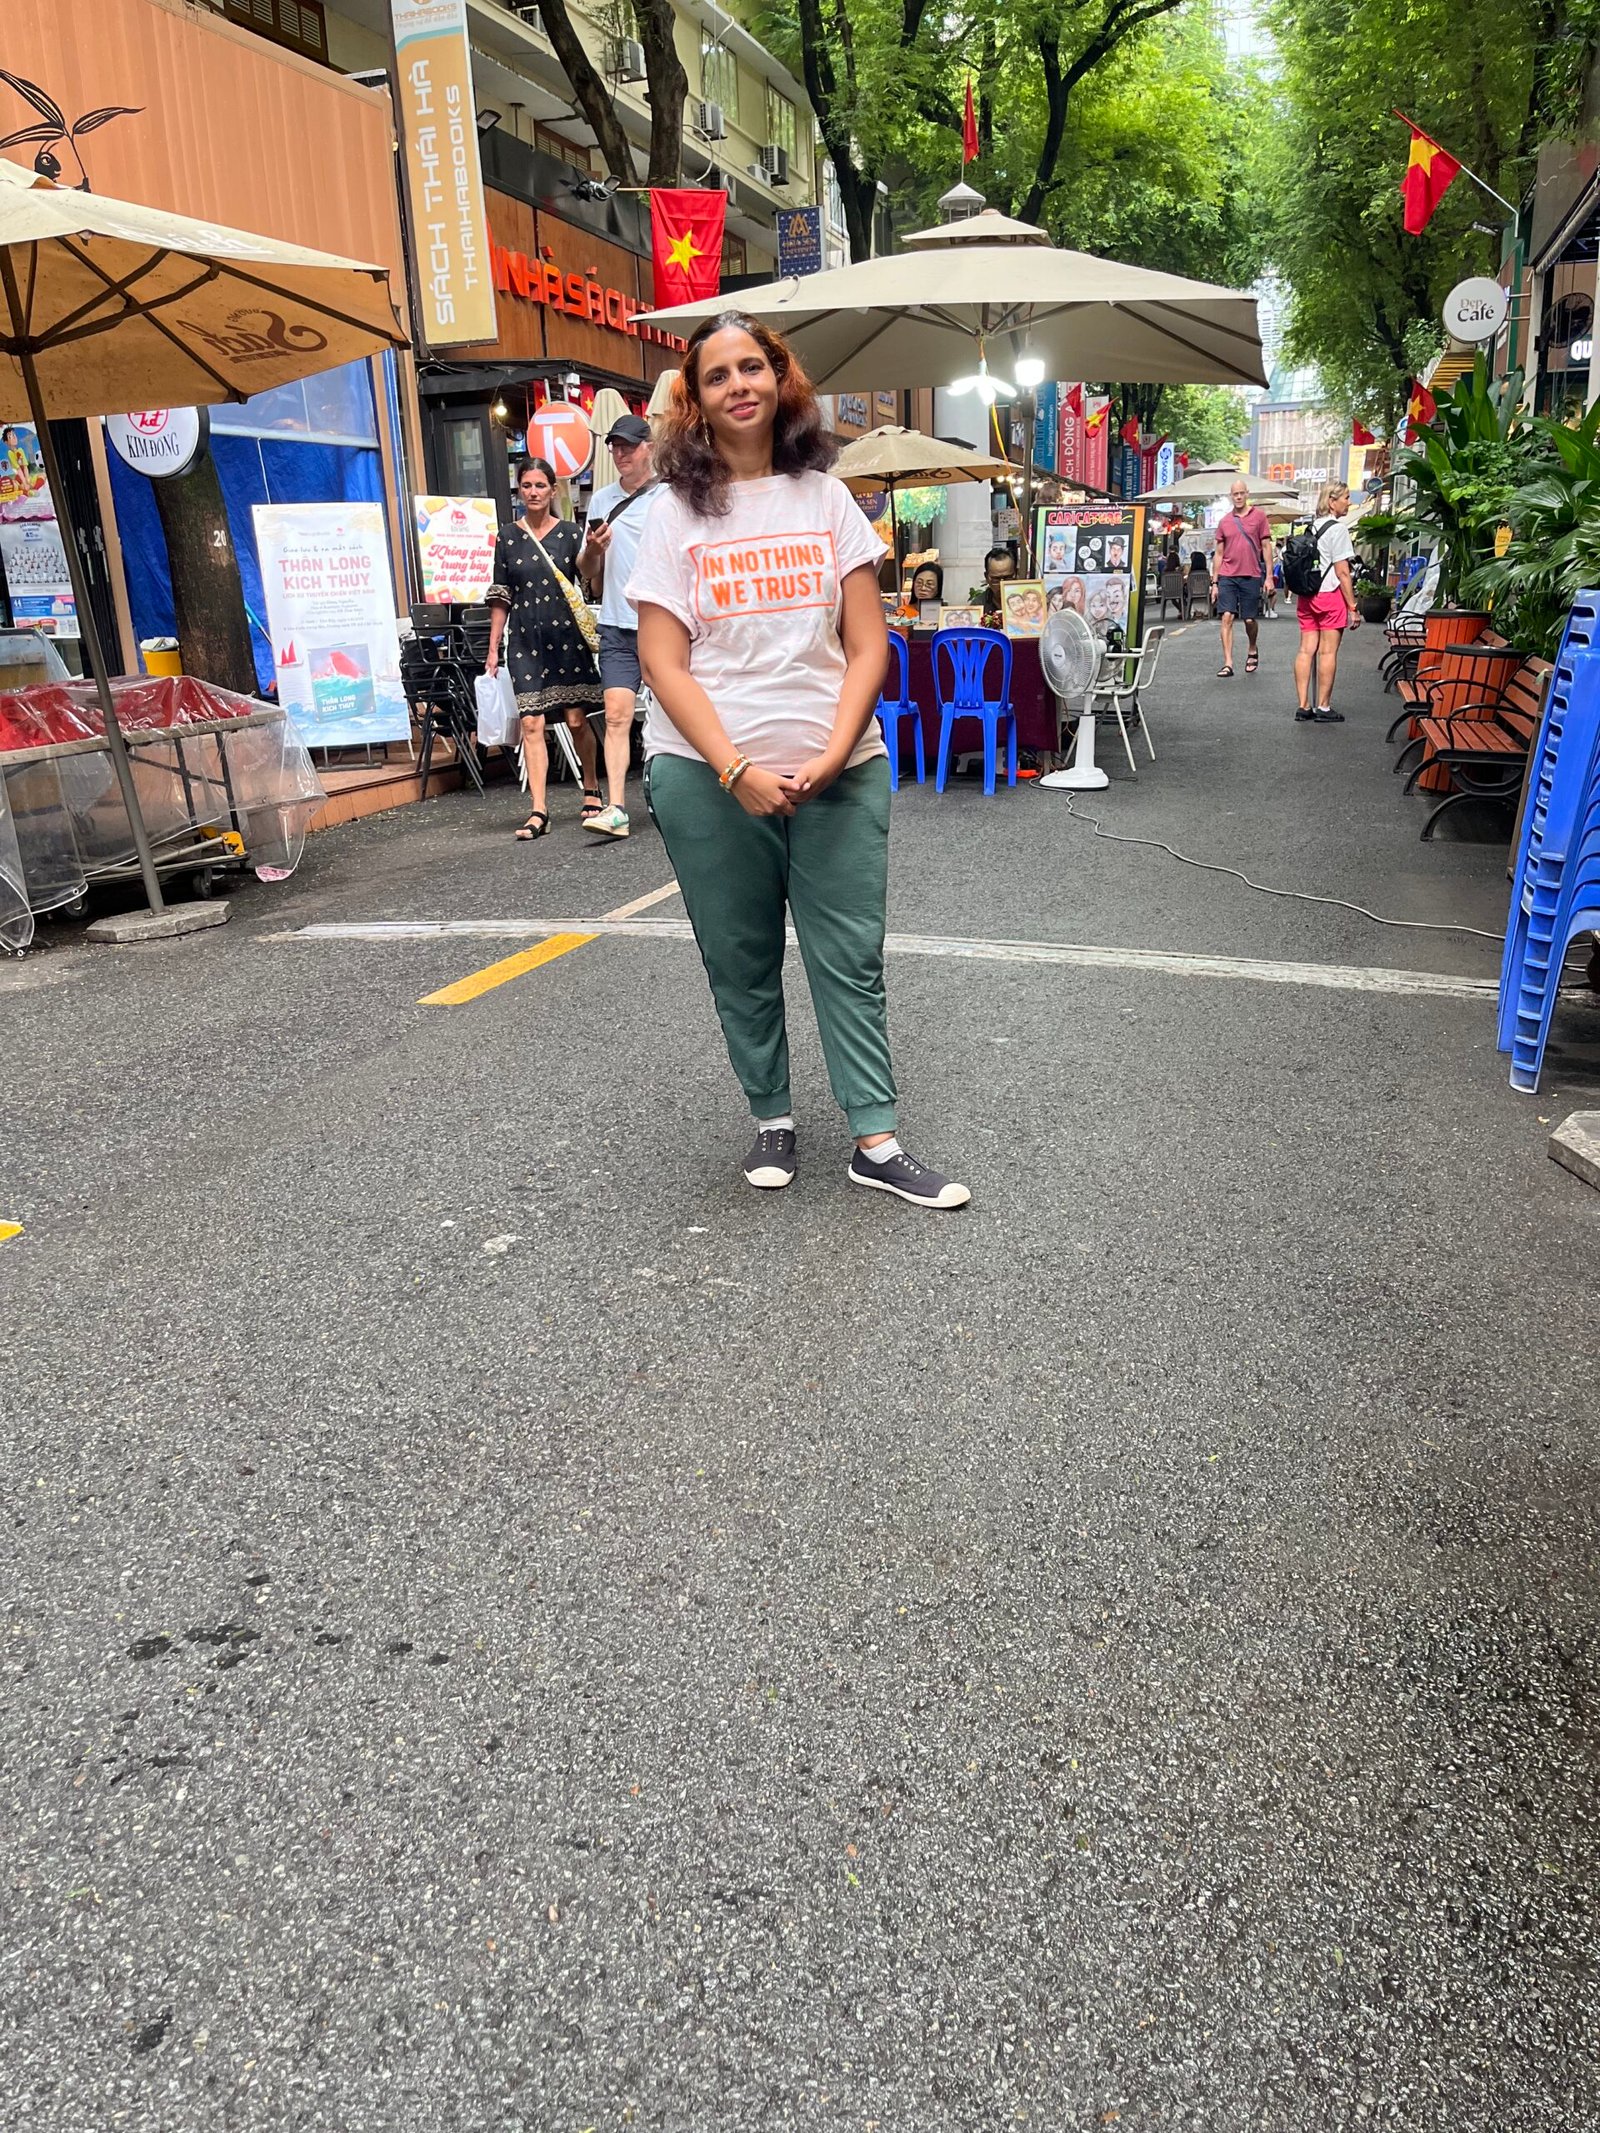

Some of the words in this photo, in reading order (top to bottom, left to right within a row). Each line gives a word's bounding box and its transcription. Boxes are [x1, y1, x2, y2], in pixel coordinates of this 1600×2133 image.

[408, 59, 434, 116] HÀ
[415, 126, 443, 213] THÁI
[446, 84, 479, 290] THAIHABOOKS
[428, 221, 455, 325] SÁCH
[496, 246, 564, 310] NHÀ
[564, 266, 637, 336] SÁCH
[1457, 303, 1495, 322] Café
[126, 434, 149, 458] KIM
[1062, 416, 1075, 456] ĐÔNG
[1161, 461, 1169, 485] SAIGON
[1048, 511, 1122, 525] CARICATURE
[329, 555, 371, 571] LONG
[427, 545, 468, 560] Không
[468, 546, 492, 560] gian
[702, 556, 725, 579] IN
[728, 544, 825, 575] NOTHING
[468, 572, 491, 582] sách
[711, 580, 748, 609] WE
[752, 571, 824, 602] TRUST
[340, 694, 356, 702] LONG
